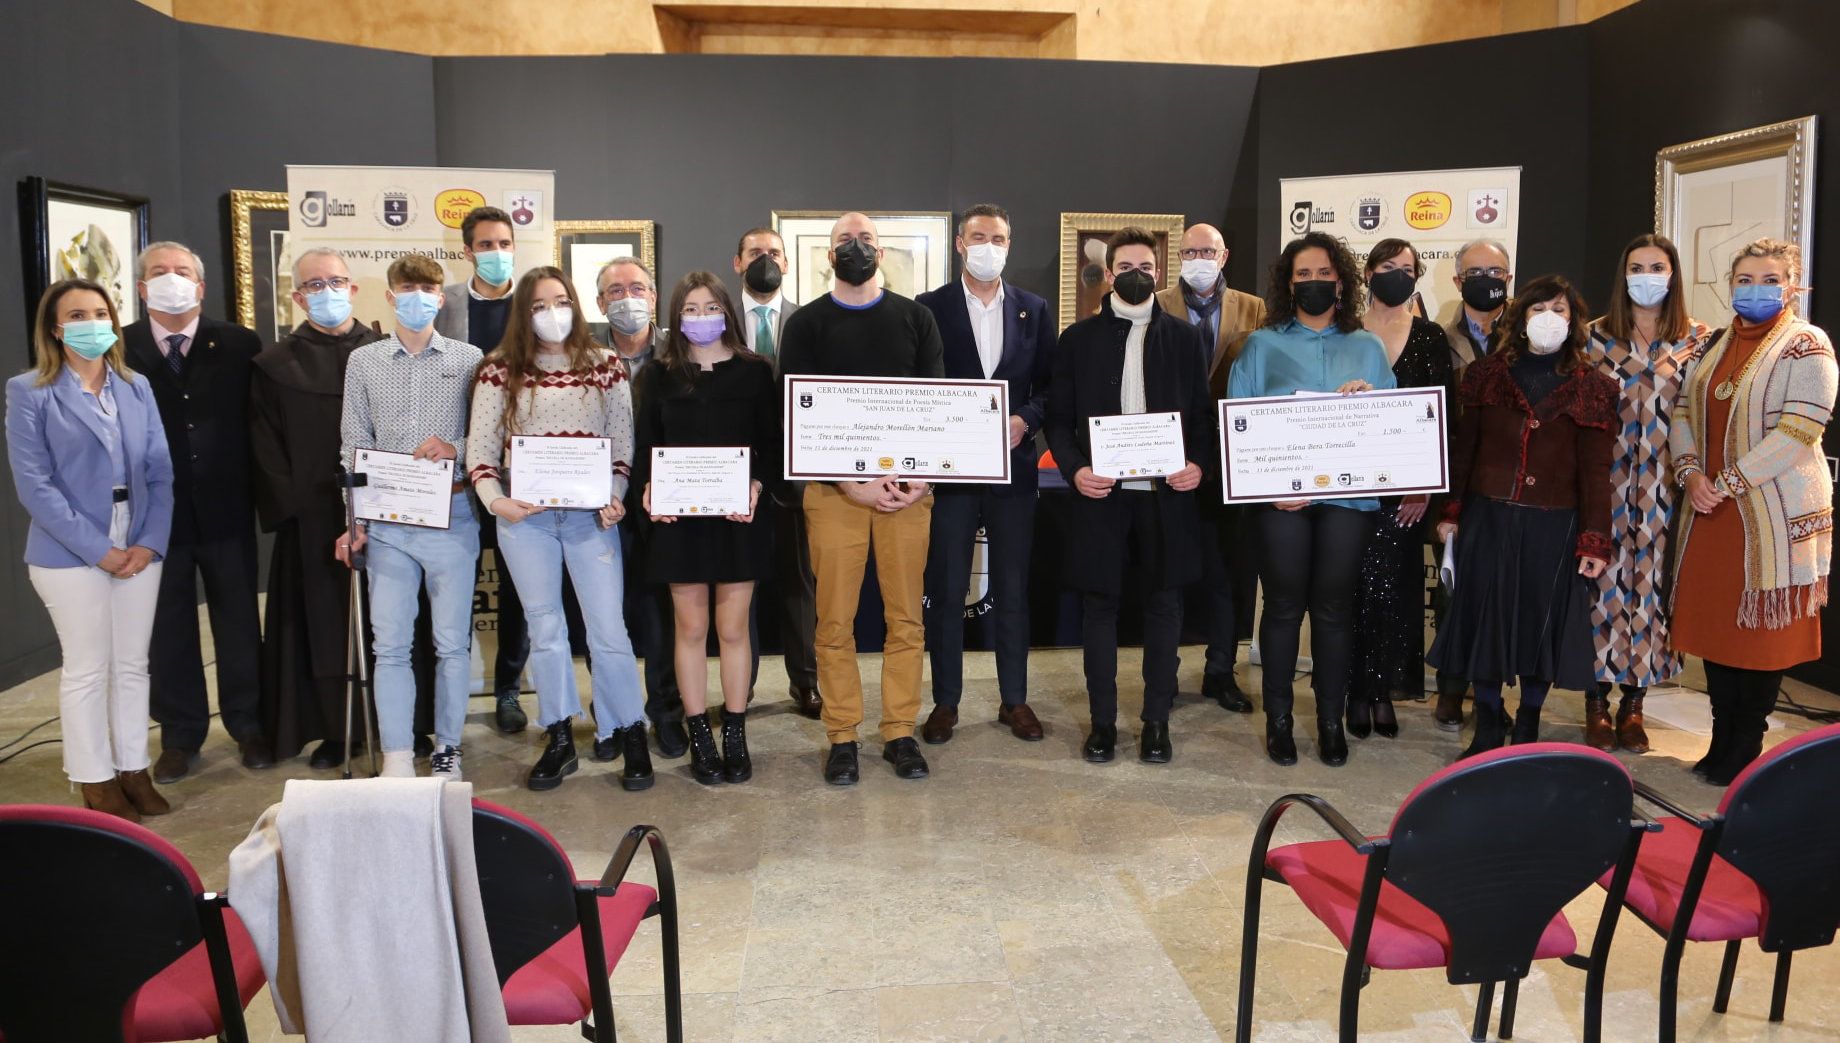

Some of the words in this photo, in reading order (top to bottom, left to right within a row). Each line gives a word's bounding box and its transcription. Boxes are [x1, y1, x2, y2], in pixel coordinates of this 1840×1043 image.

[1410, 210, 1444, 221] Reina
[817, 386, 860, 395] CERTAMEN
[862, 387, 903, 396] LITERARIO
[905, 388, 935, 397] PREMIO
[937, 388, 978, 398] ALBACARA
[1250, 407, 1293, 416] CERTAMEN
[1295, 404, 1337, 413] LITERARIO
[1338, 402, 1369, 411] PREMIO
[1371, 400, 1413, 409] ALBACARA
[852, 422, 884, 432] Alejandro
[818, 432, 832, 440] Tres
[833, 432, 845, 440] mil
